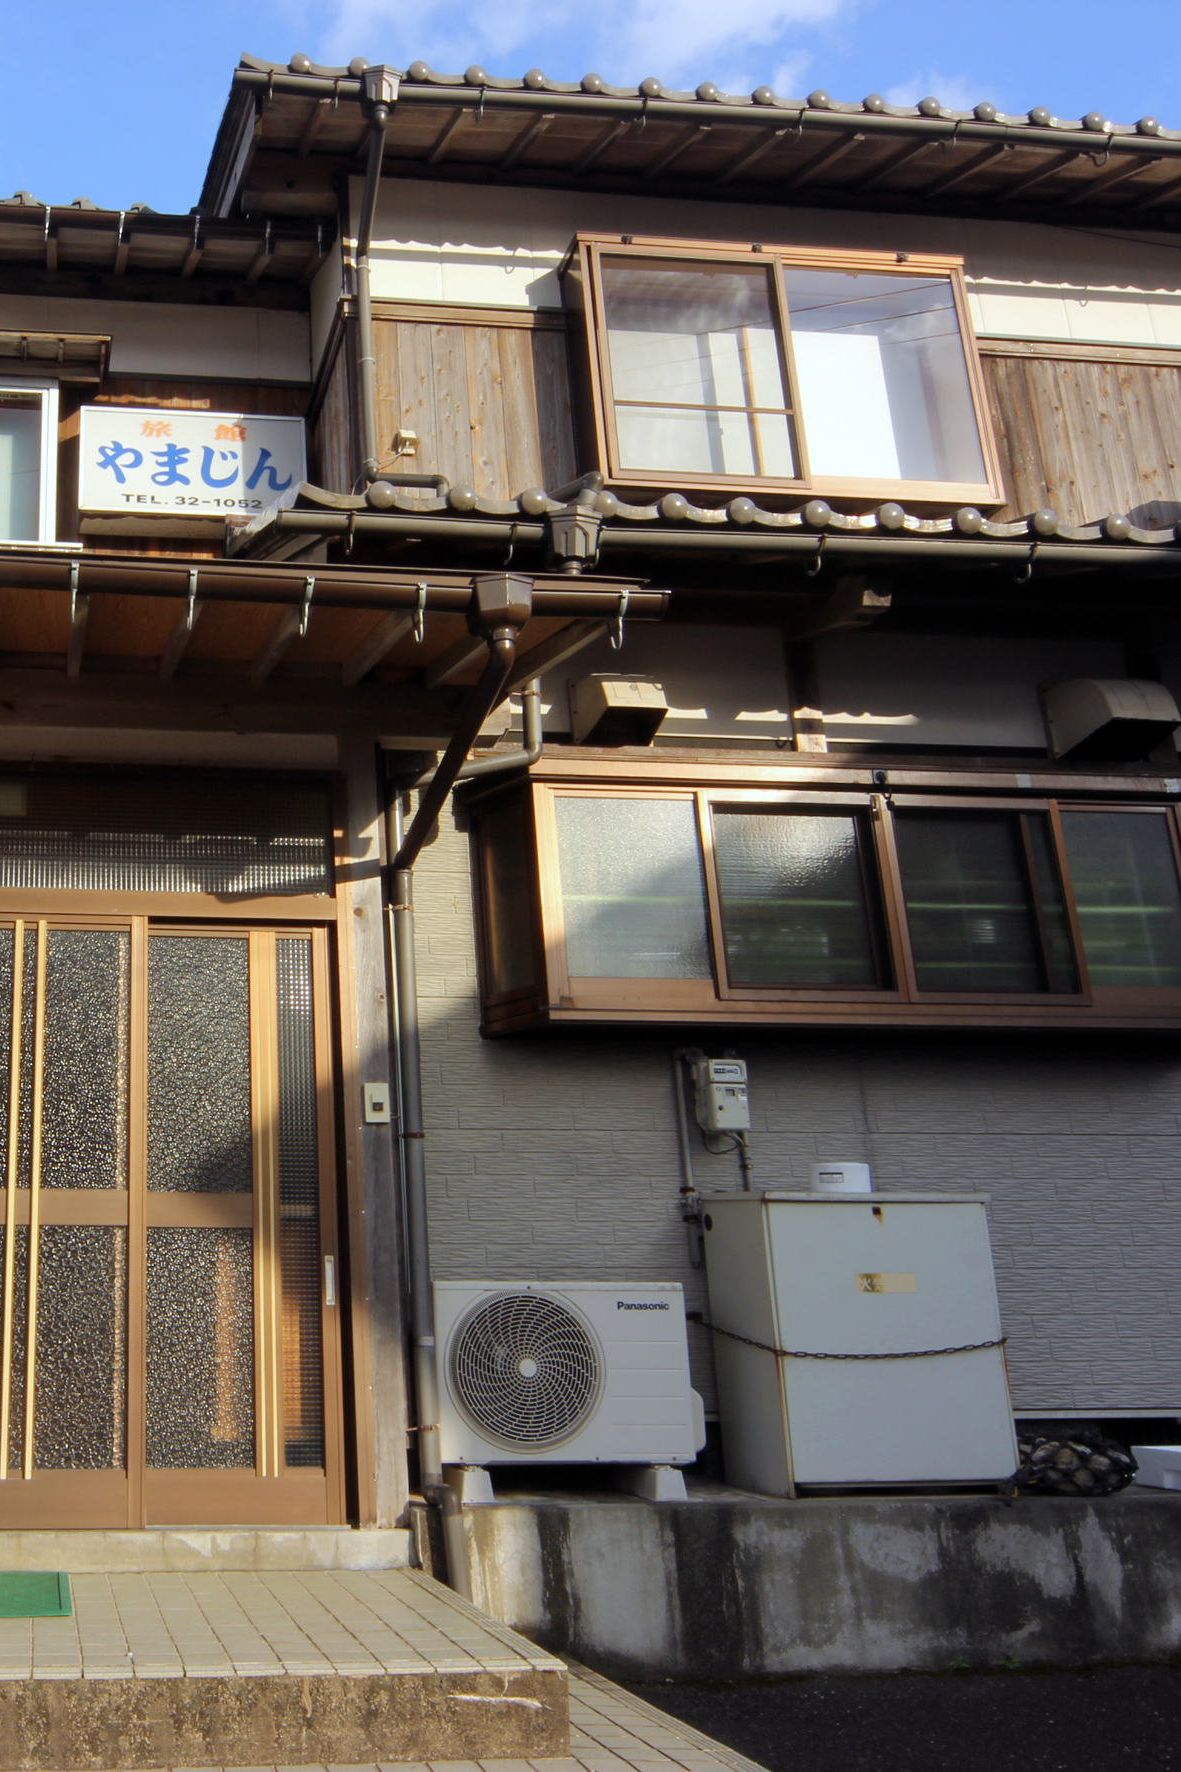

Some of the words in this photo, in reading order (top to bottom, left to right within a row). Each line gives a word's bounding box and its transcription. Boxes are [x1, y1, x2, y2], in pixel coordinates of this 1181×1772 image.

[140, 420, 247, 442] 旅館
[96, 440, 293, 491] やまじん
[121, 493, 169, 505] TEL.
[174, 496, 263, 510] 32-1052
[616, 1301, 670, 1311] Panasonic
